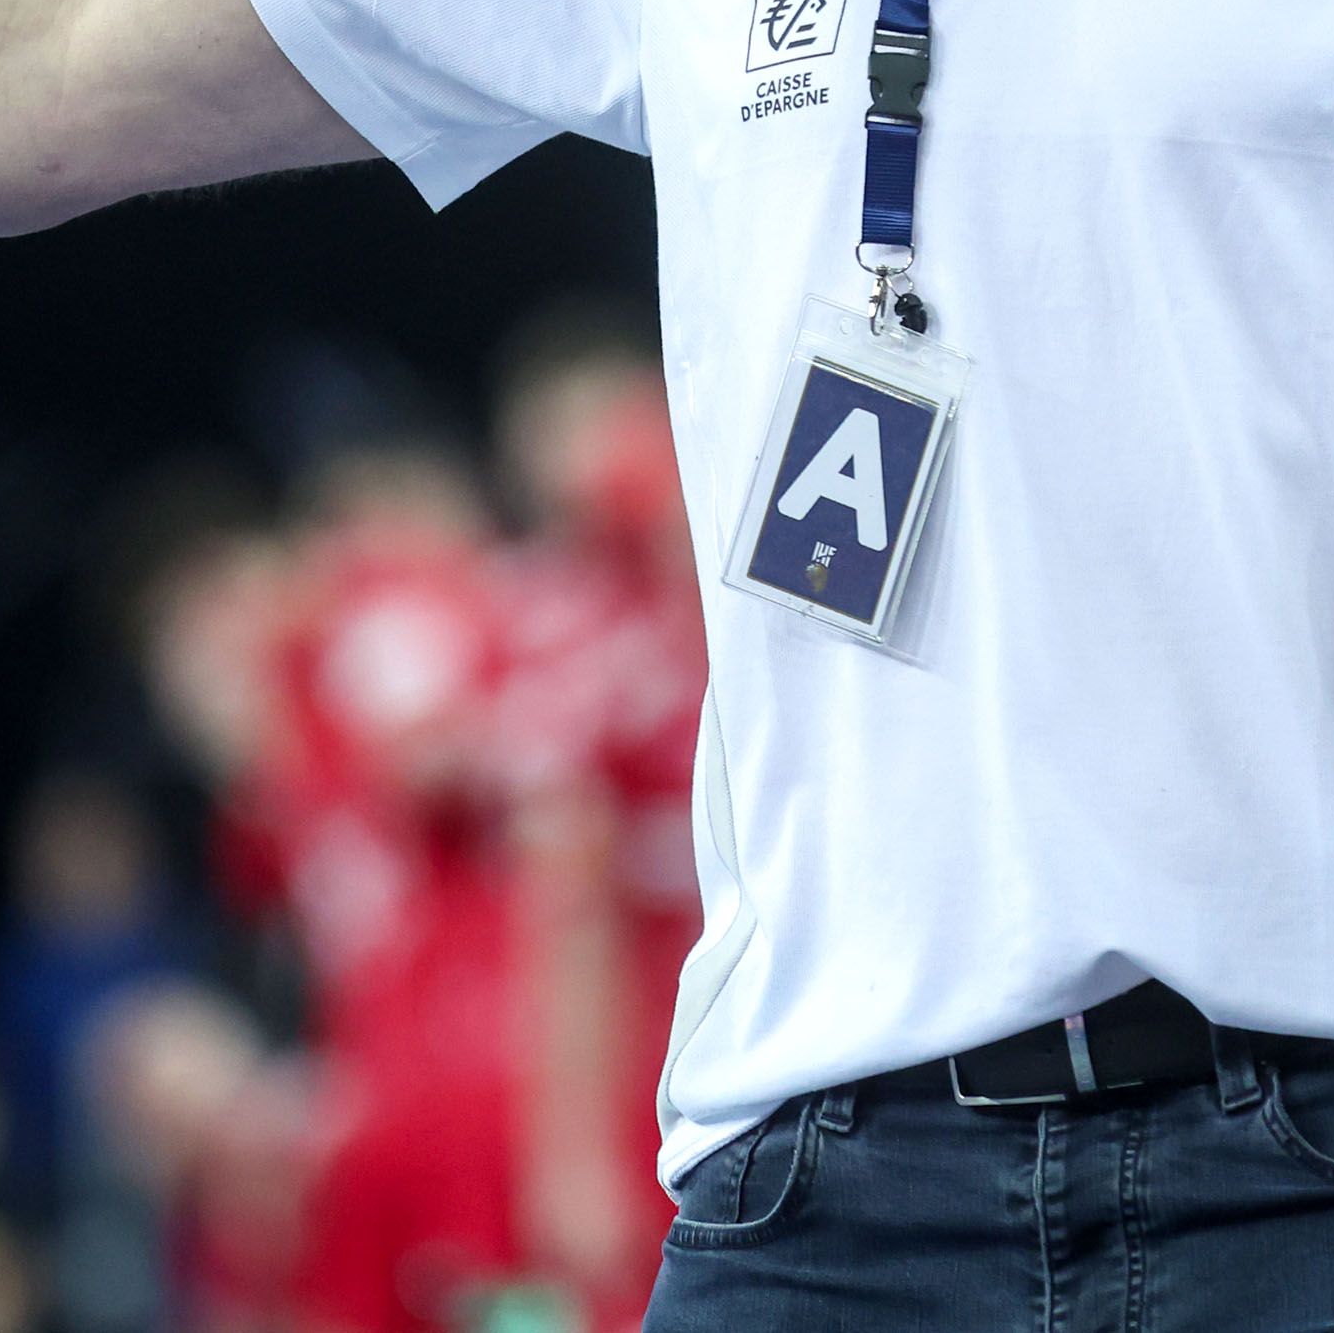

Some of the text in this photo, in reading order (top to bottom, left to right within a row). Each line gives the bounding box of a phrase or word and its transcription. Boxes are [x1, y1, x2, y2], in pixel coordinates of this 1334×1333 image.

[756, 72, 812, 98] CAISSE
[741, 87, 829, 122] D'EPARGNE
[777, 407, 888, 552] A
